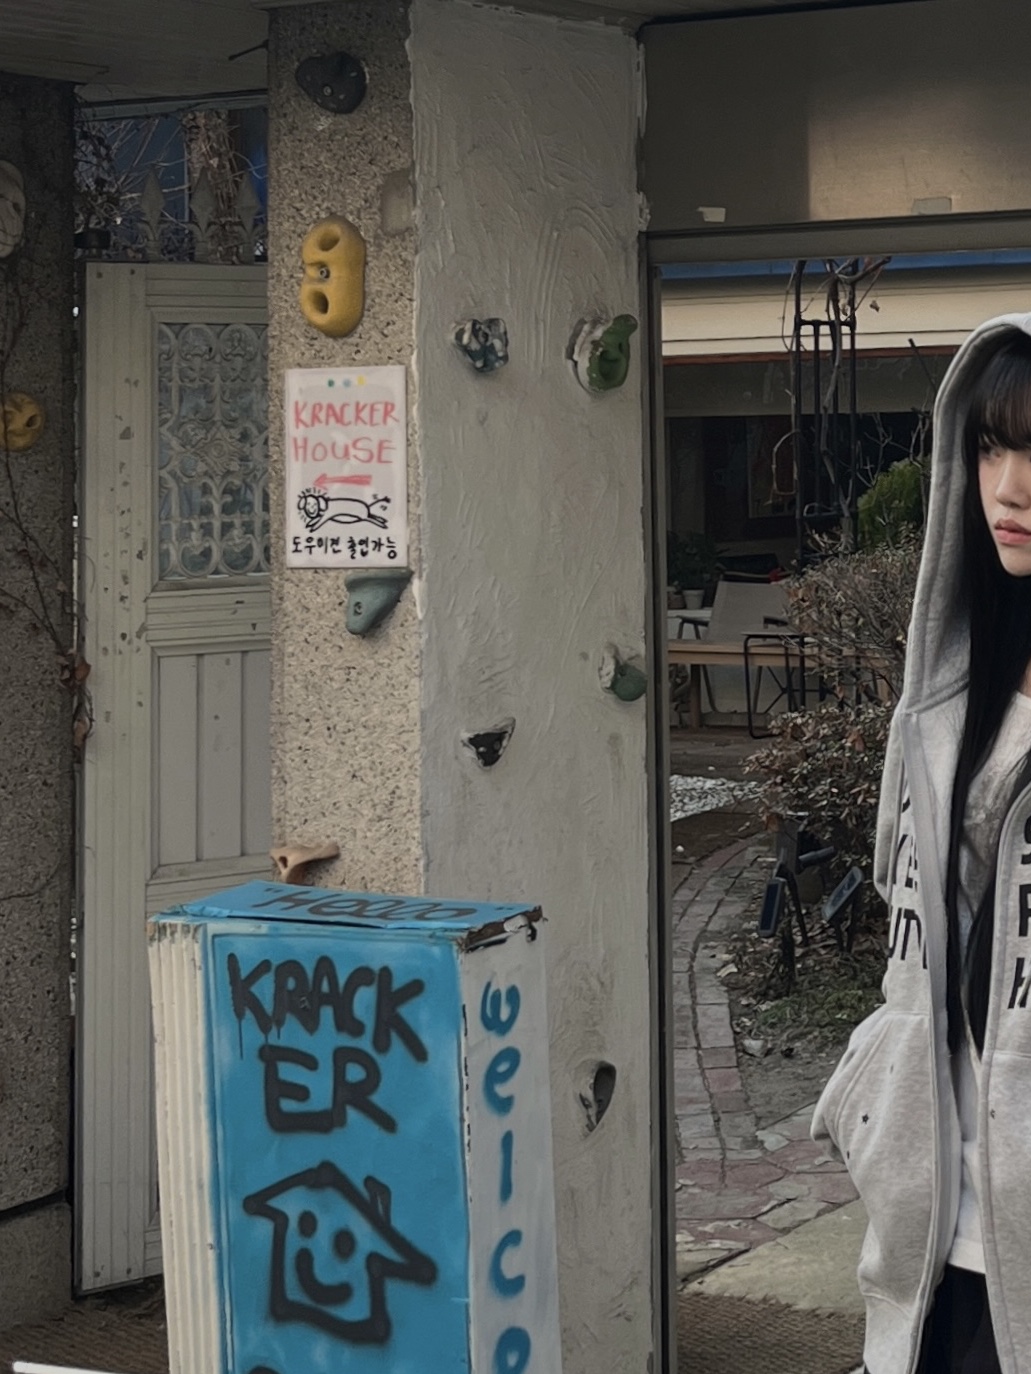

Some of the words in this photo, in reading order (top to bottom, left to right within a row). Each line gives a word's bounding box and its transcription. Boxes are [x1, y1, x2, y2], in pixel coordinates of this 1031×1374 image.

[294, 400, 399, 428] KRACKER
[226, 952, 428, 1063] KRACK
[258, 1044, 398, 1134] ER
